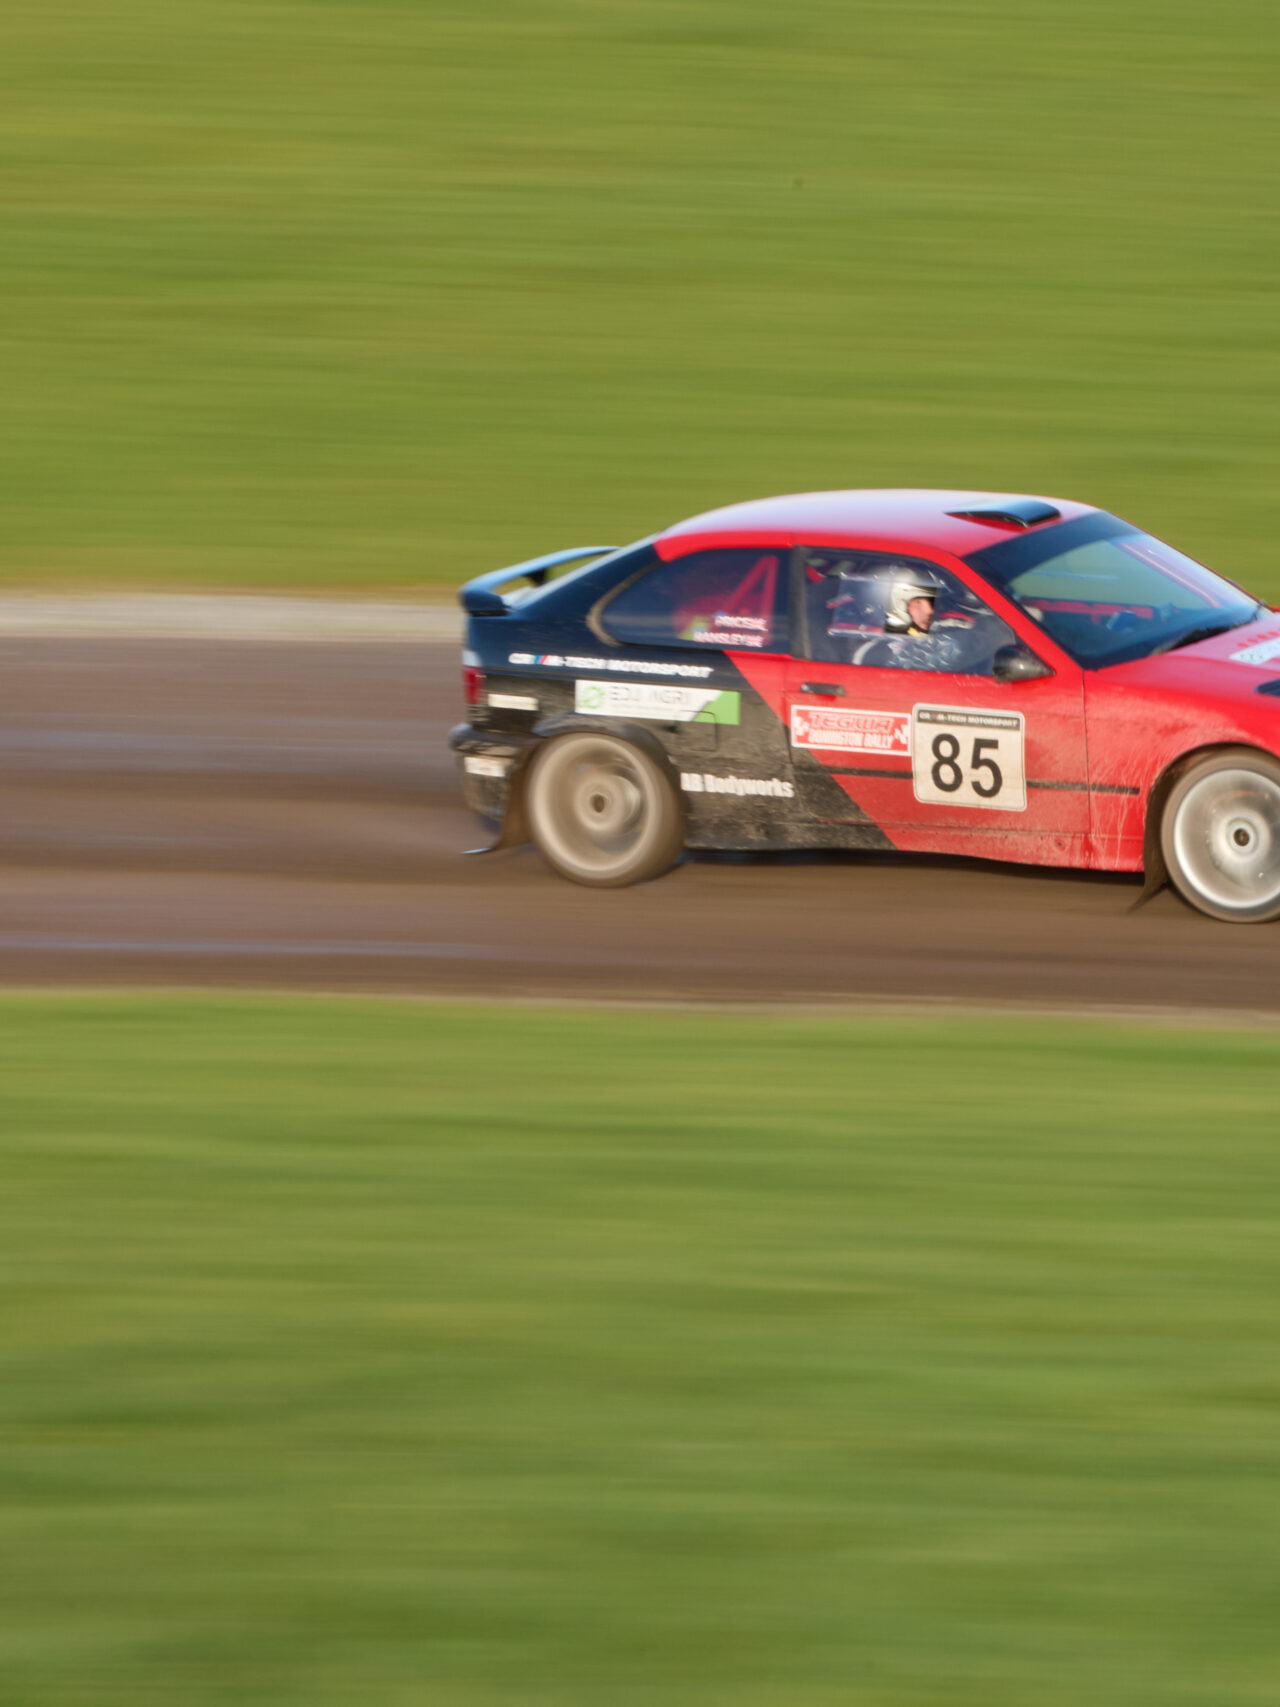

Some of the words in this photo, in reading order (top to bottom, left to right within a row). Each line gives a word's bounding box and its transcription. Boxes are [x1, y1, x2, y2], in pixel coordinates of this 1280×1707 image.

[607, 659, 714, 678] MOTORSPORT
[968, 716, 1018, 728] MOTORSPORT
[864, 733, 895, 750] RALLY
[931, 733, 1003, 798] 85
[704, 773, 795, 798] Bodyworks
